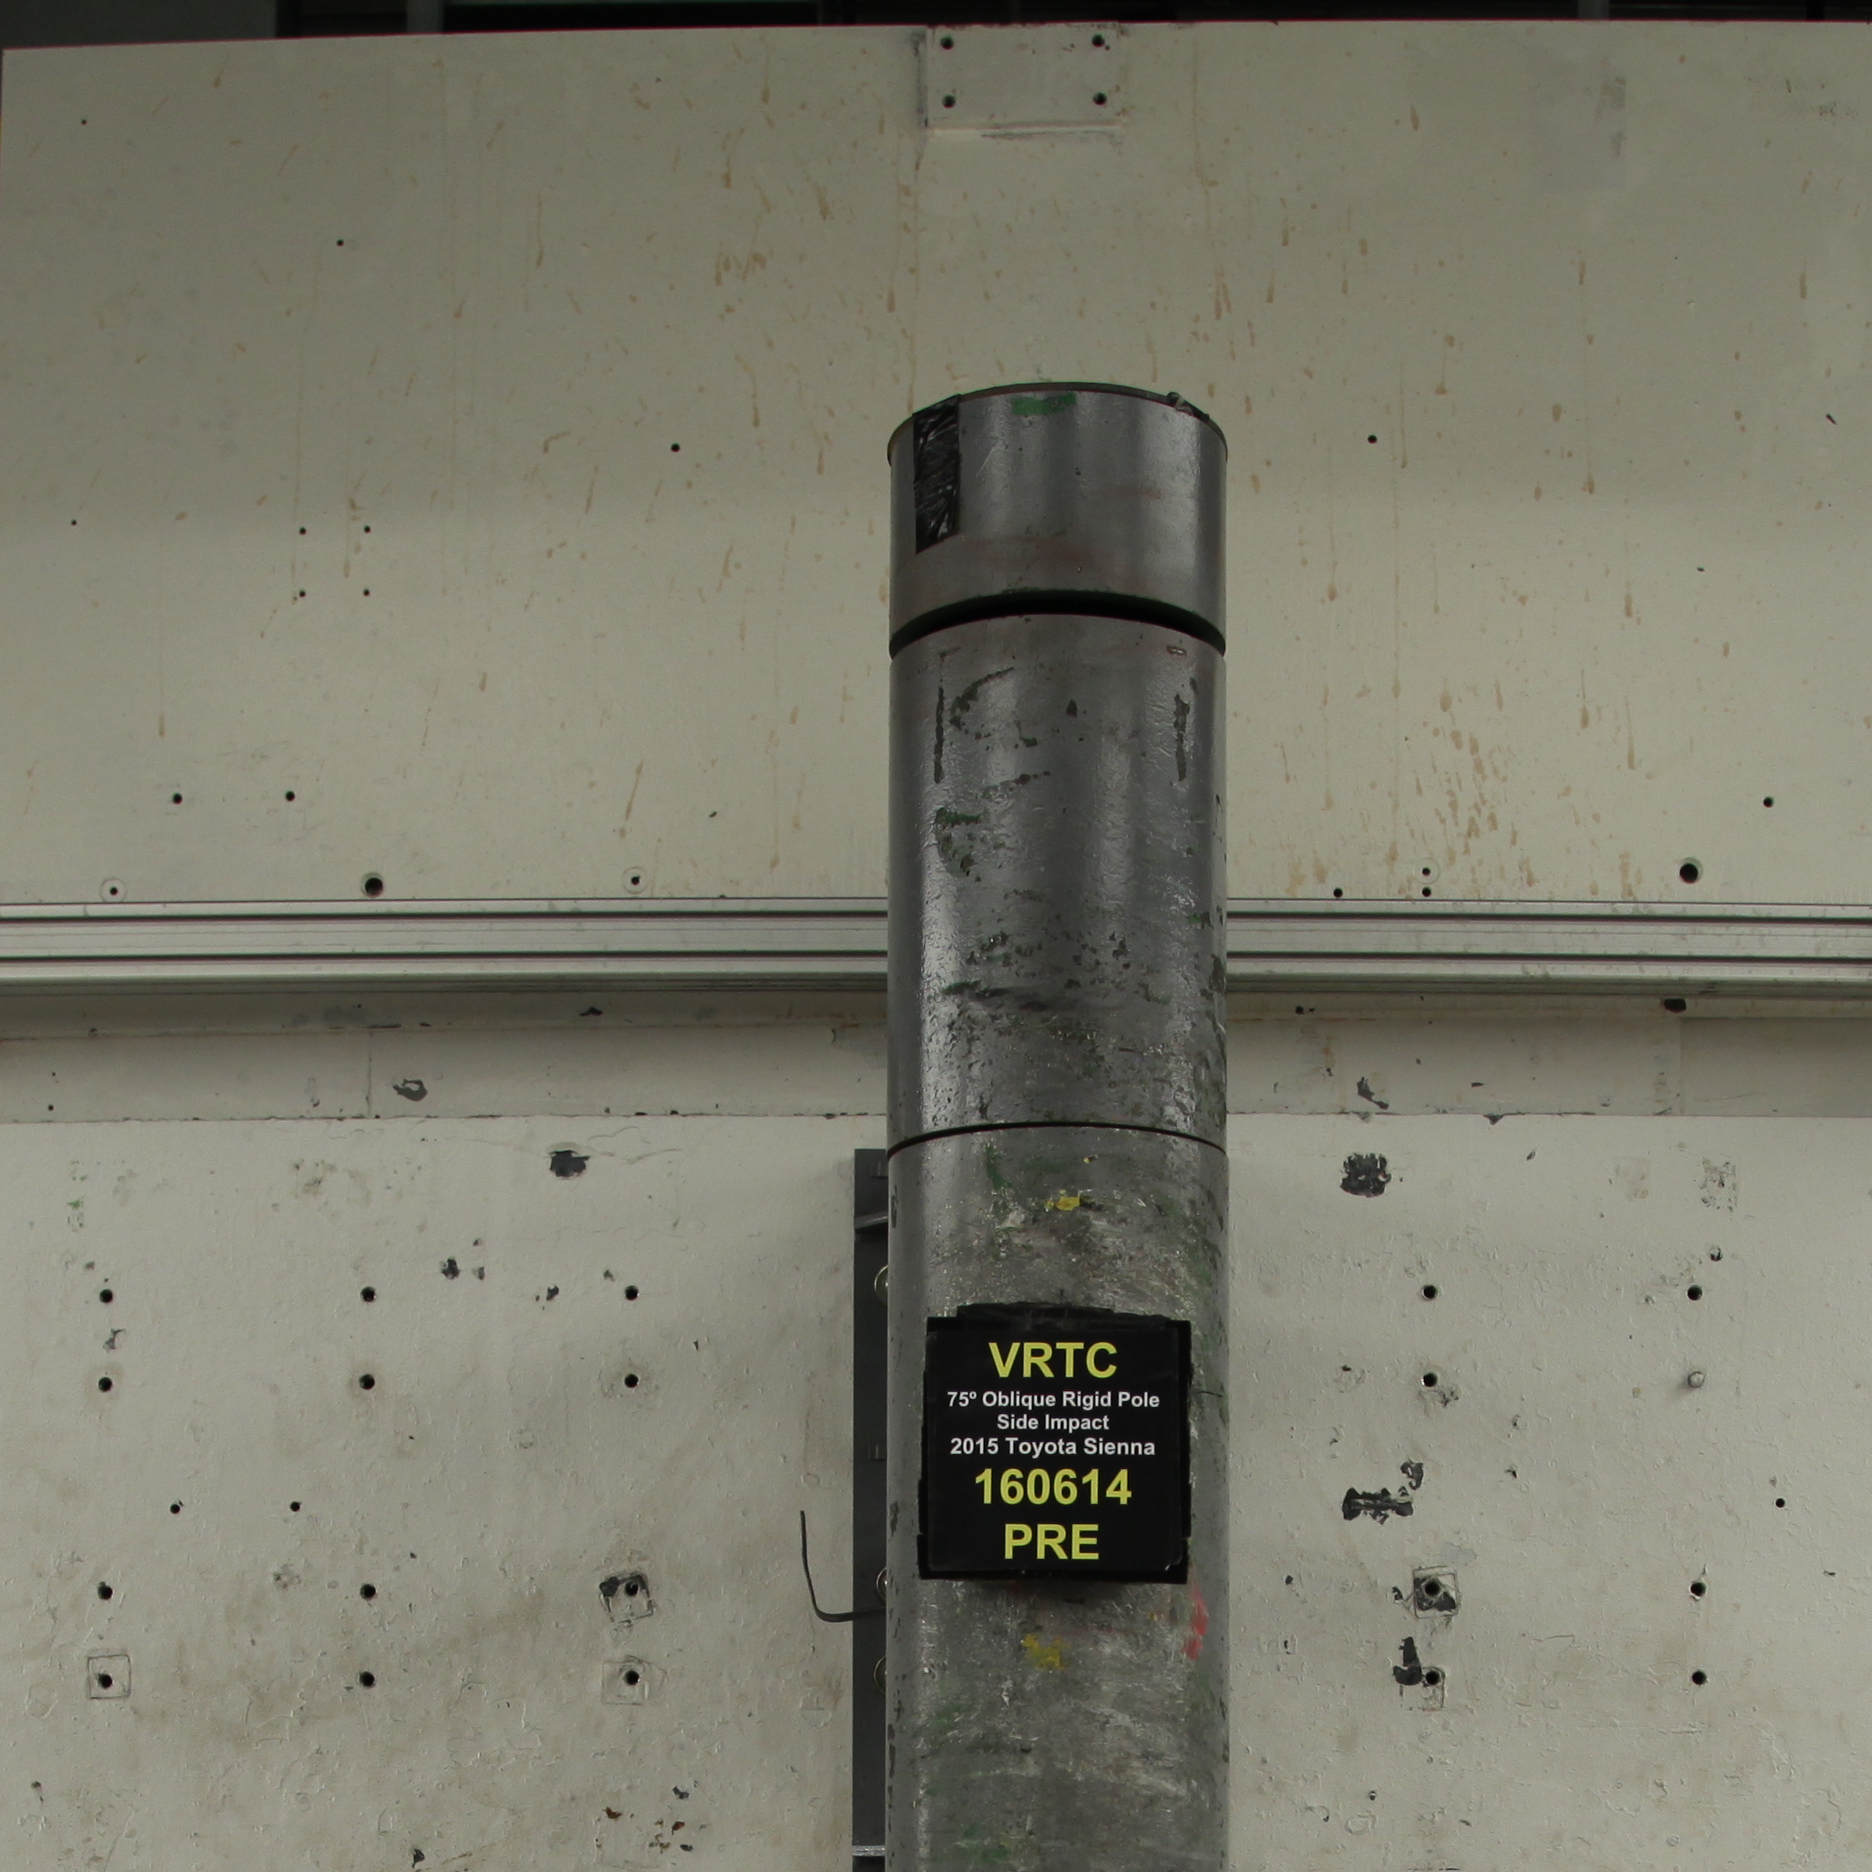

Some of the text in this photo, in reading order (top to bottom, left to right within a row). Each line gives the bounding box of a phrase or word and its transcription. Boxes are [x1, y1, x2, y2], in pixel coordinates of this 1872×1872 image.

[988, 1341, 1118, 1379] VRTC
[982, 1390, 1056, 1411] Oblique
[1062, 1390, 1112, 1411] Rigid
[1118, 1391, 1160, 1408] Pole
[996, 1413, 1110, 1434] Side Impact
[949, 1436, 1156, 1459] 2015 Toyota Sienna
[975, 1468, 1132, 1505] 160614
[1004, 1523, 1100, 1560] PRE
